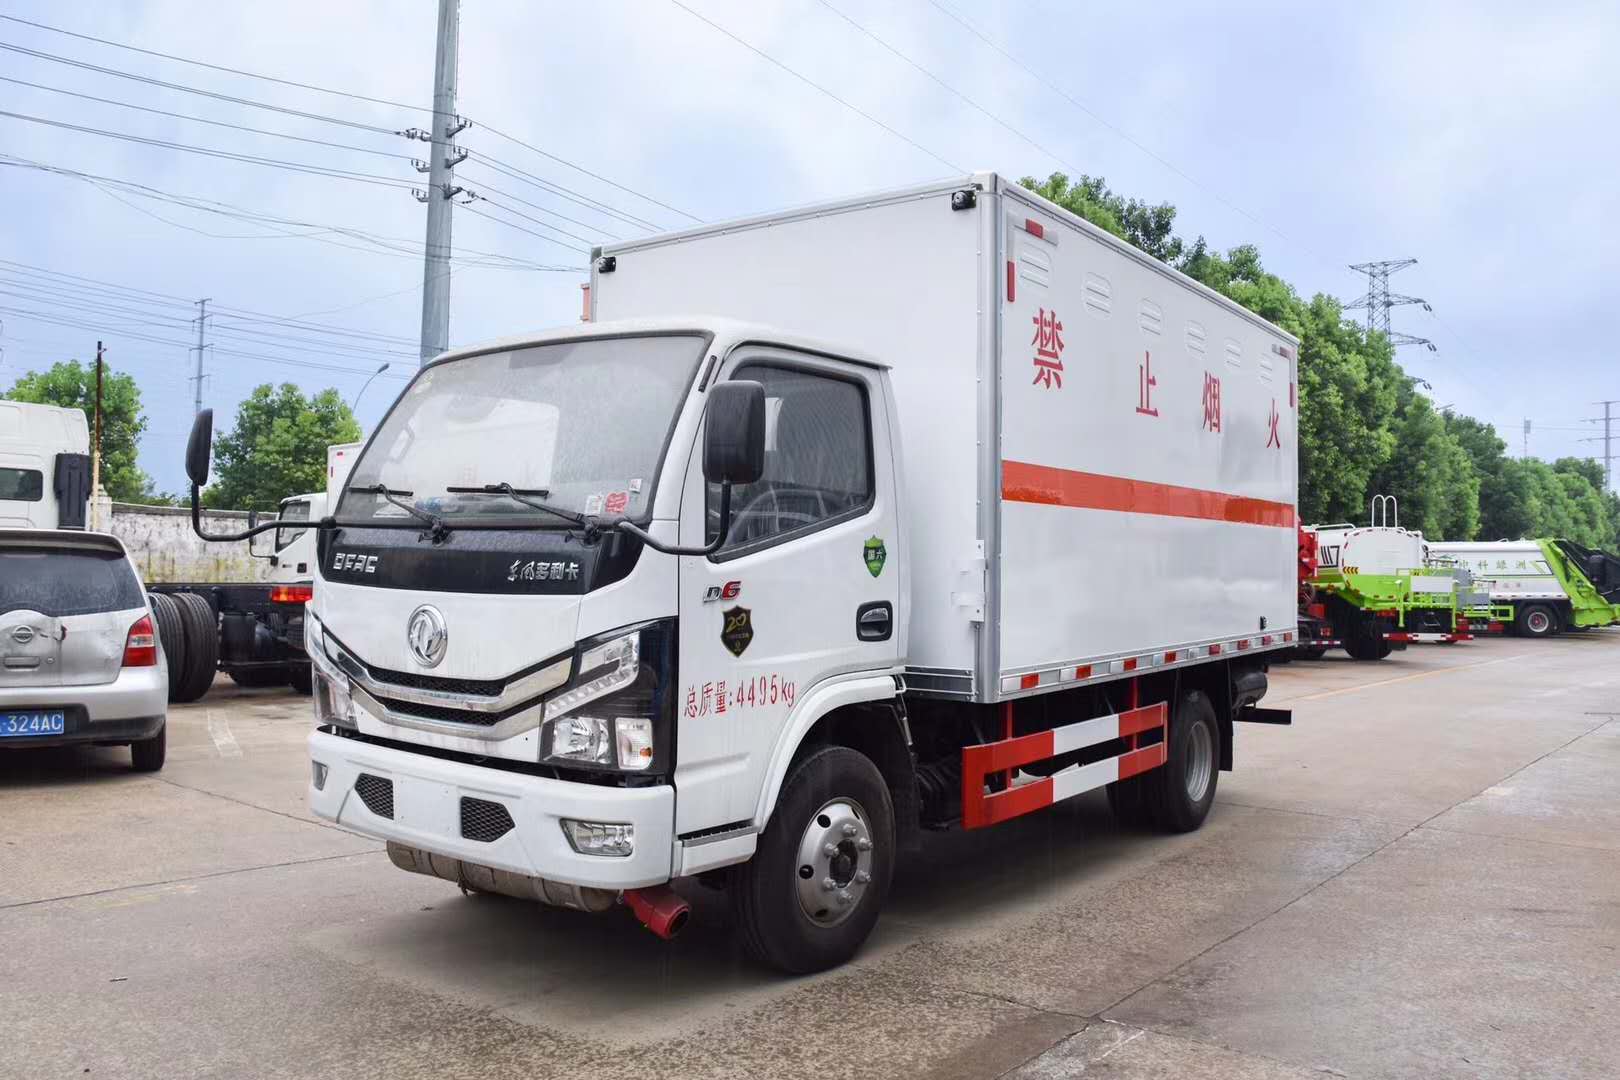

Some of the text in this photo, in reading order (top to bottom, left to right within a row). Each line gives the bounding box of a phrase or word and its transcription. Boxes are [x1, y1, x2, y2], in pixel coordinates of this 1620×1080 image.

[1031, 307, 1281, 449] 禁止烟火
[333, 552, 379, 573] DFAC
[507, 559, 579, 581] 东风多利卡
[703, 581, 741, 602] D6
